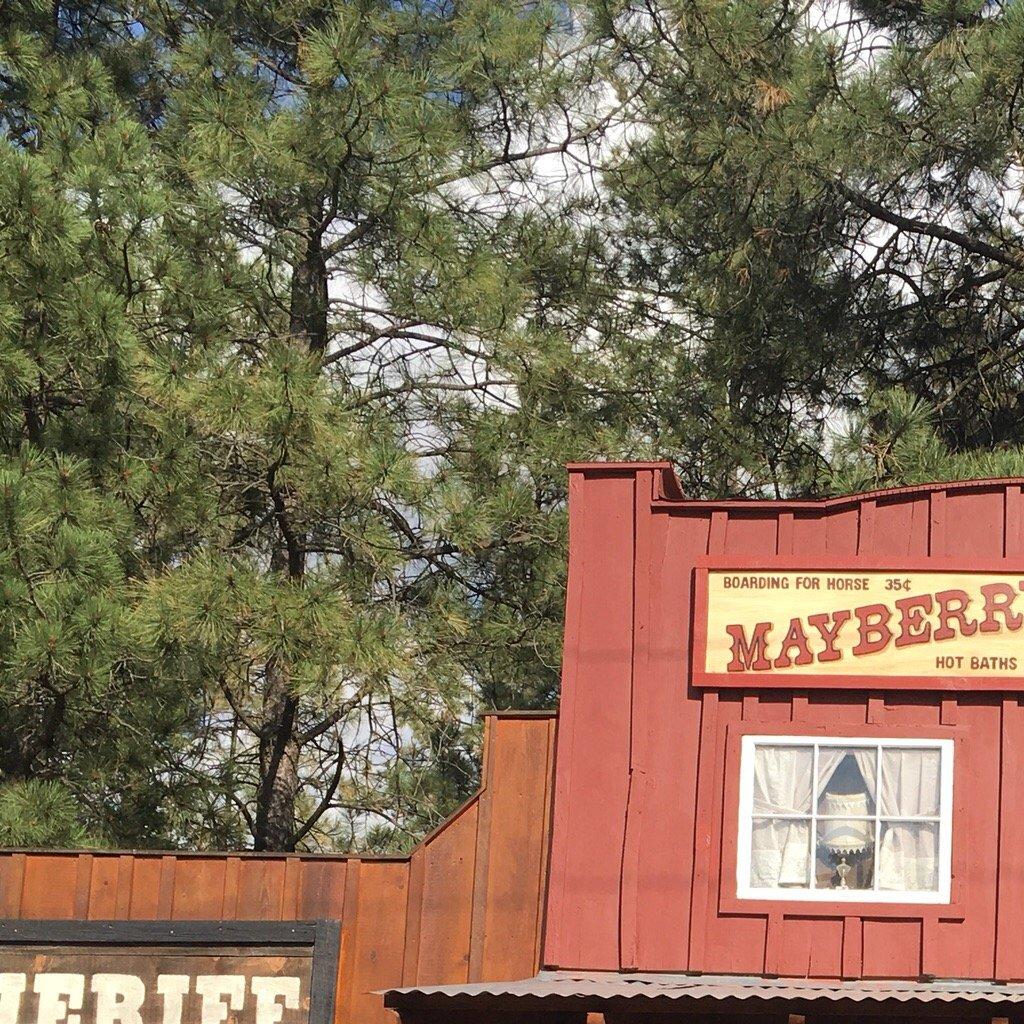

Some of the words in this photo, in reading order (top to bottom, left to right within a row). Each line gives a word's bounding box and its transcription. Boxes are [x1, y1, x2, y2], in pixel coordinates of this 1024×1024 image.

[723, 576, 790, 590] BOARDING
[795, 576, 820, 590] FOR
[827, 577, 870, 591] HORSE
[884, 578, 912, 592] 35¢
[935, 656, 964, 670] HOT
[970, 656, 1018, 671] BATHS
